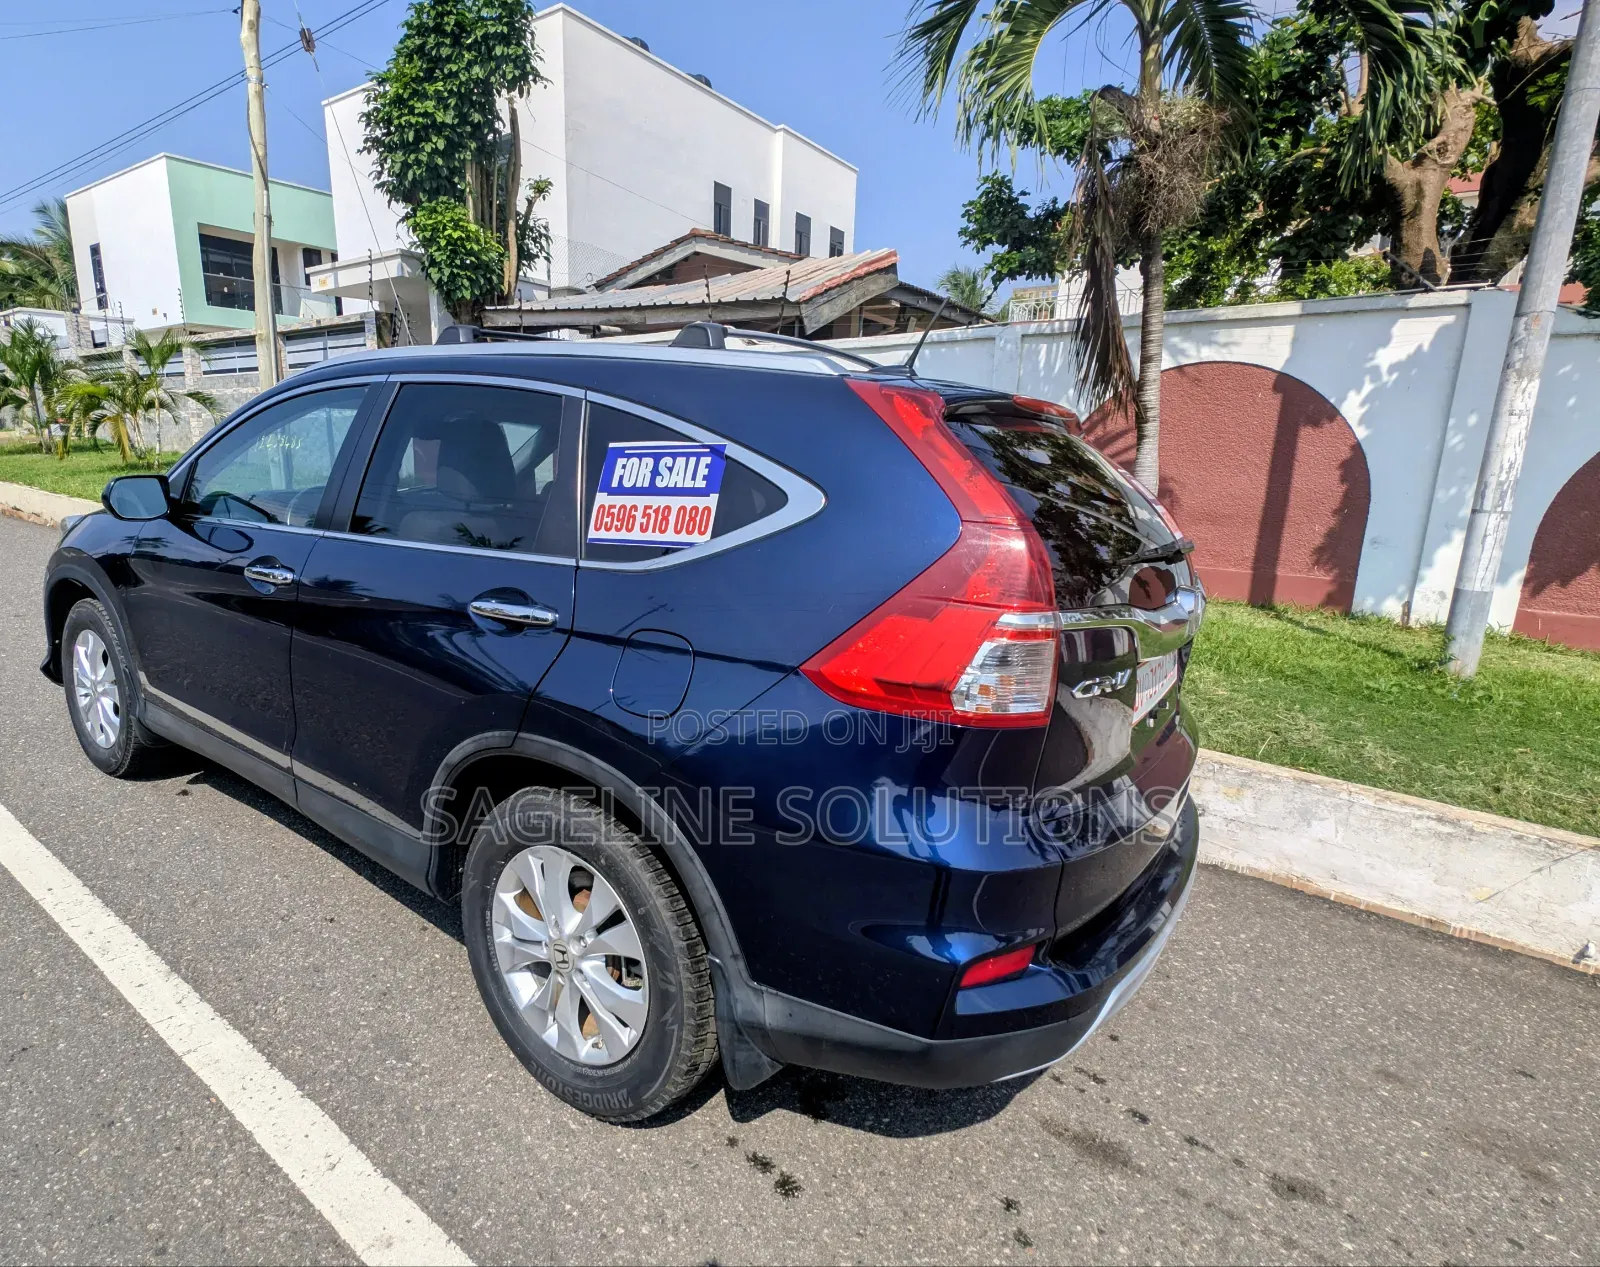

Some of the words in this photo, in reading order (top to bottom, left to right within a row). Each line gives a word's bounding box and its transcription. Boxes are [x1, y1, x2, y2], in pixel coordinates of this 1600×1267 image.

[611, 457, 655, 488] FOR
[655, 457, 712, 488] SALE
[593, 504, 639, 533] 0596
[639, 505, 672, 535] 518
[673, 505, 712, 536] 080
[527, 1061, 635, 1110] BRIDGESTONE
